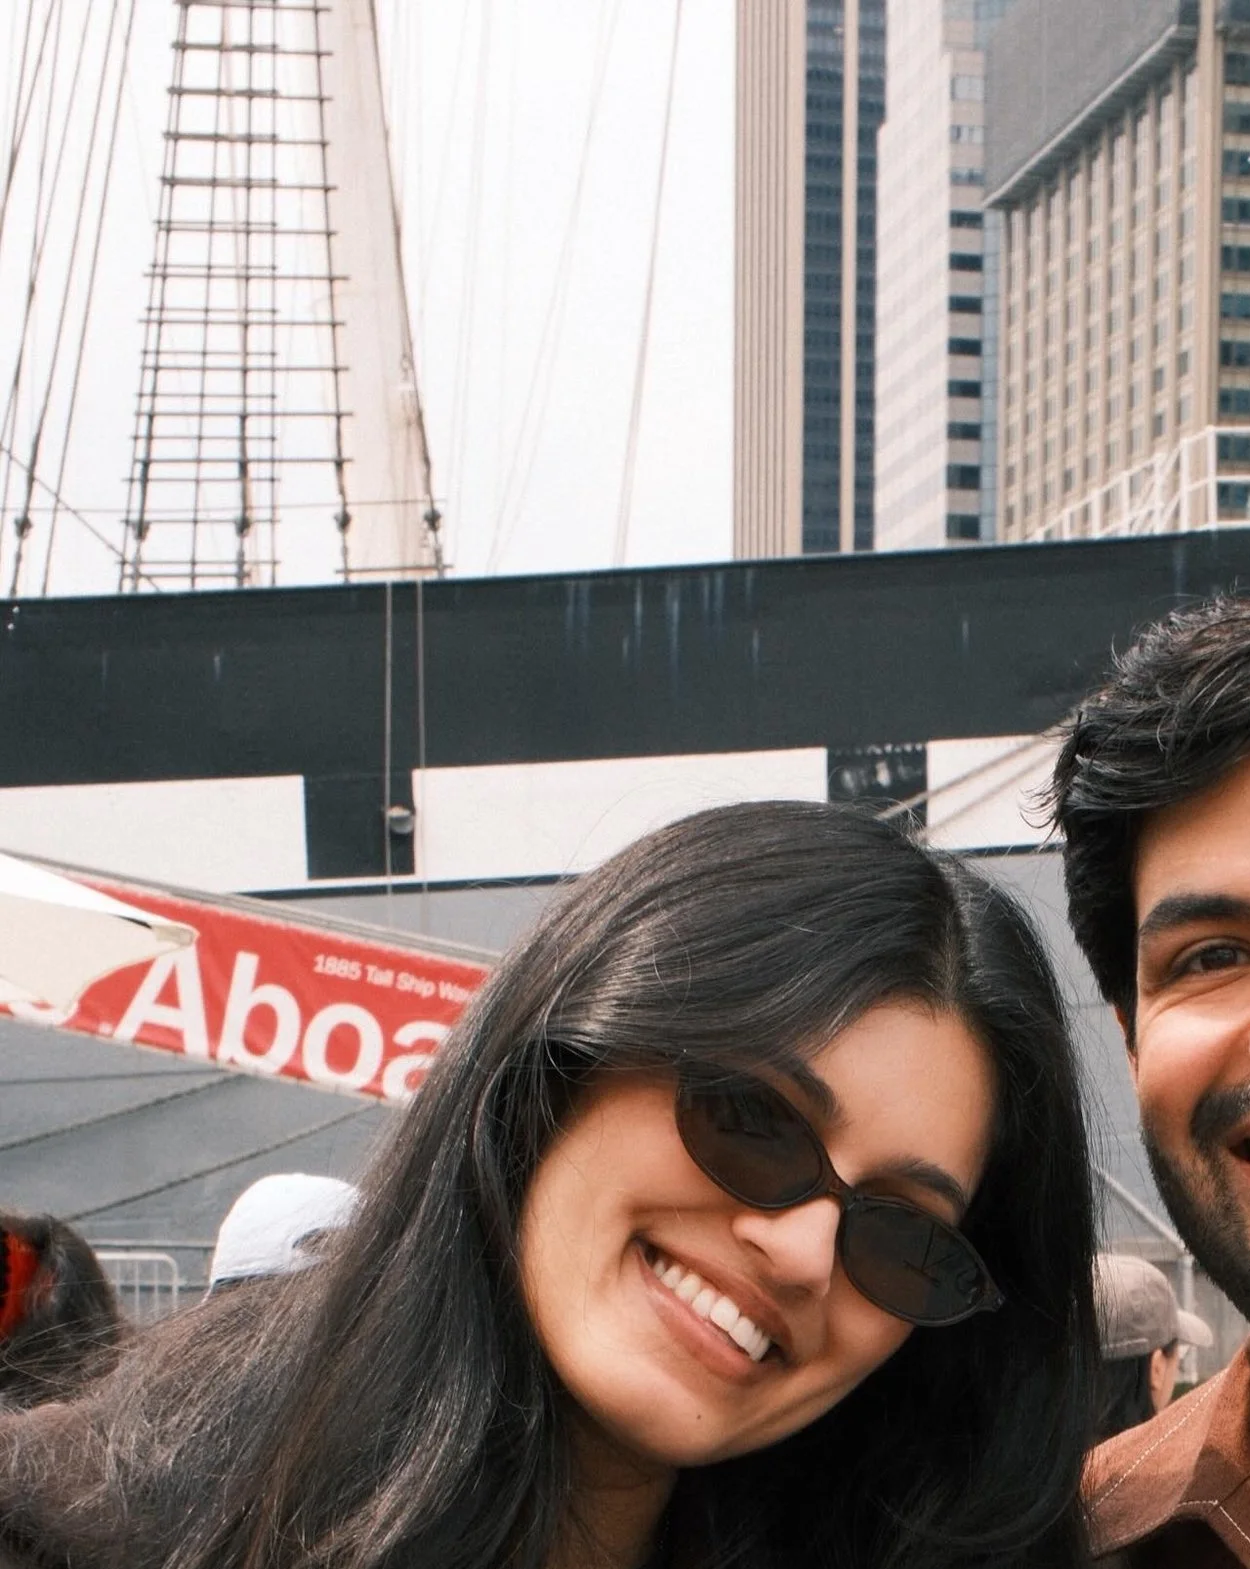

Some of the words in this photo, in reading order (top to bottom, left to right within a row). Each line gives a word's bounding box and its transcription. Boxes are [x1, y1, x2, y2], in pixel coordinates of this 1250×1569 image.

[313, 954, 362, 981] 1885
[365, 964, 395, 988] Tall
[396, 972, 436, 999] Ship
